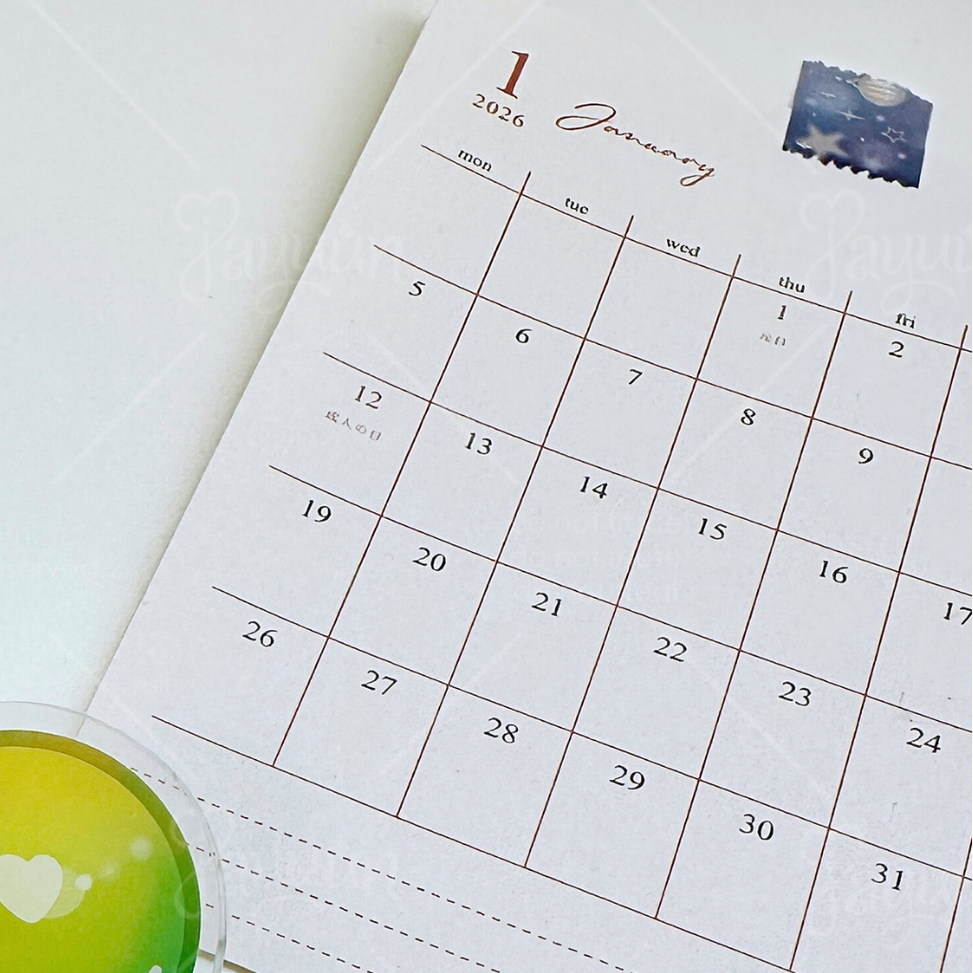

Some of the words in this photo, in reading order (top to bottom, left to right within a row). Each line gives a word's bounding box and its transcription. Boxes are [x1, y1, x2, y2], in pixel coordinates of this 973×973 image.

[471, 93, 525, 128] 2026
[496, 50, 530, 99] 1
[555, 102, 716, 188] January
[457, 149, 493, 173] mon
[564, 197, 590, 215] tue
[666, 238, 701, 258] wed
[778, 276, 806, 294] thu
[894, 312, 917, 330] fri
[407, 280, 426, 297] 5
[514, 328, 533, 344] 6
[628, 368, 644, 386] 7
[740, 407, 757, 427] 8
[857, 447, 874, 465] 9
[776, 304, 787, 321] 1
[888, 340, 905, 359] 2
[354, 385, 383, 410] 12
[464, 432, 493, 456] 13
[579, 475, 608, 500] 14
[697, 517, 728, 541] 15
[818, 559, 849, 584] 16
[942, 601, 973, 626] 17
[301, 499, 332, 523] 19
[411, 546, 447, 572] 20
[530, 591, 563, 618] 21
[652, 636, 688, 663] 22
[777, 680, 812, 707] 23
[905, 727, 942, 754] 24
[241, 620, 279, 648] 26
[360, 669, 398, 696] 27
[483, 716, 519, 744] 28
[608, 764, 646, 791] 29
[738, 813, 775, 841] 30
[870, 862, 904, 892] 31
